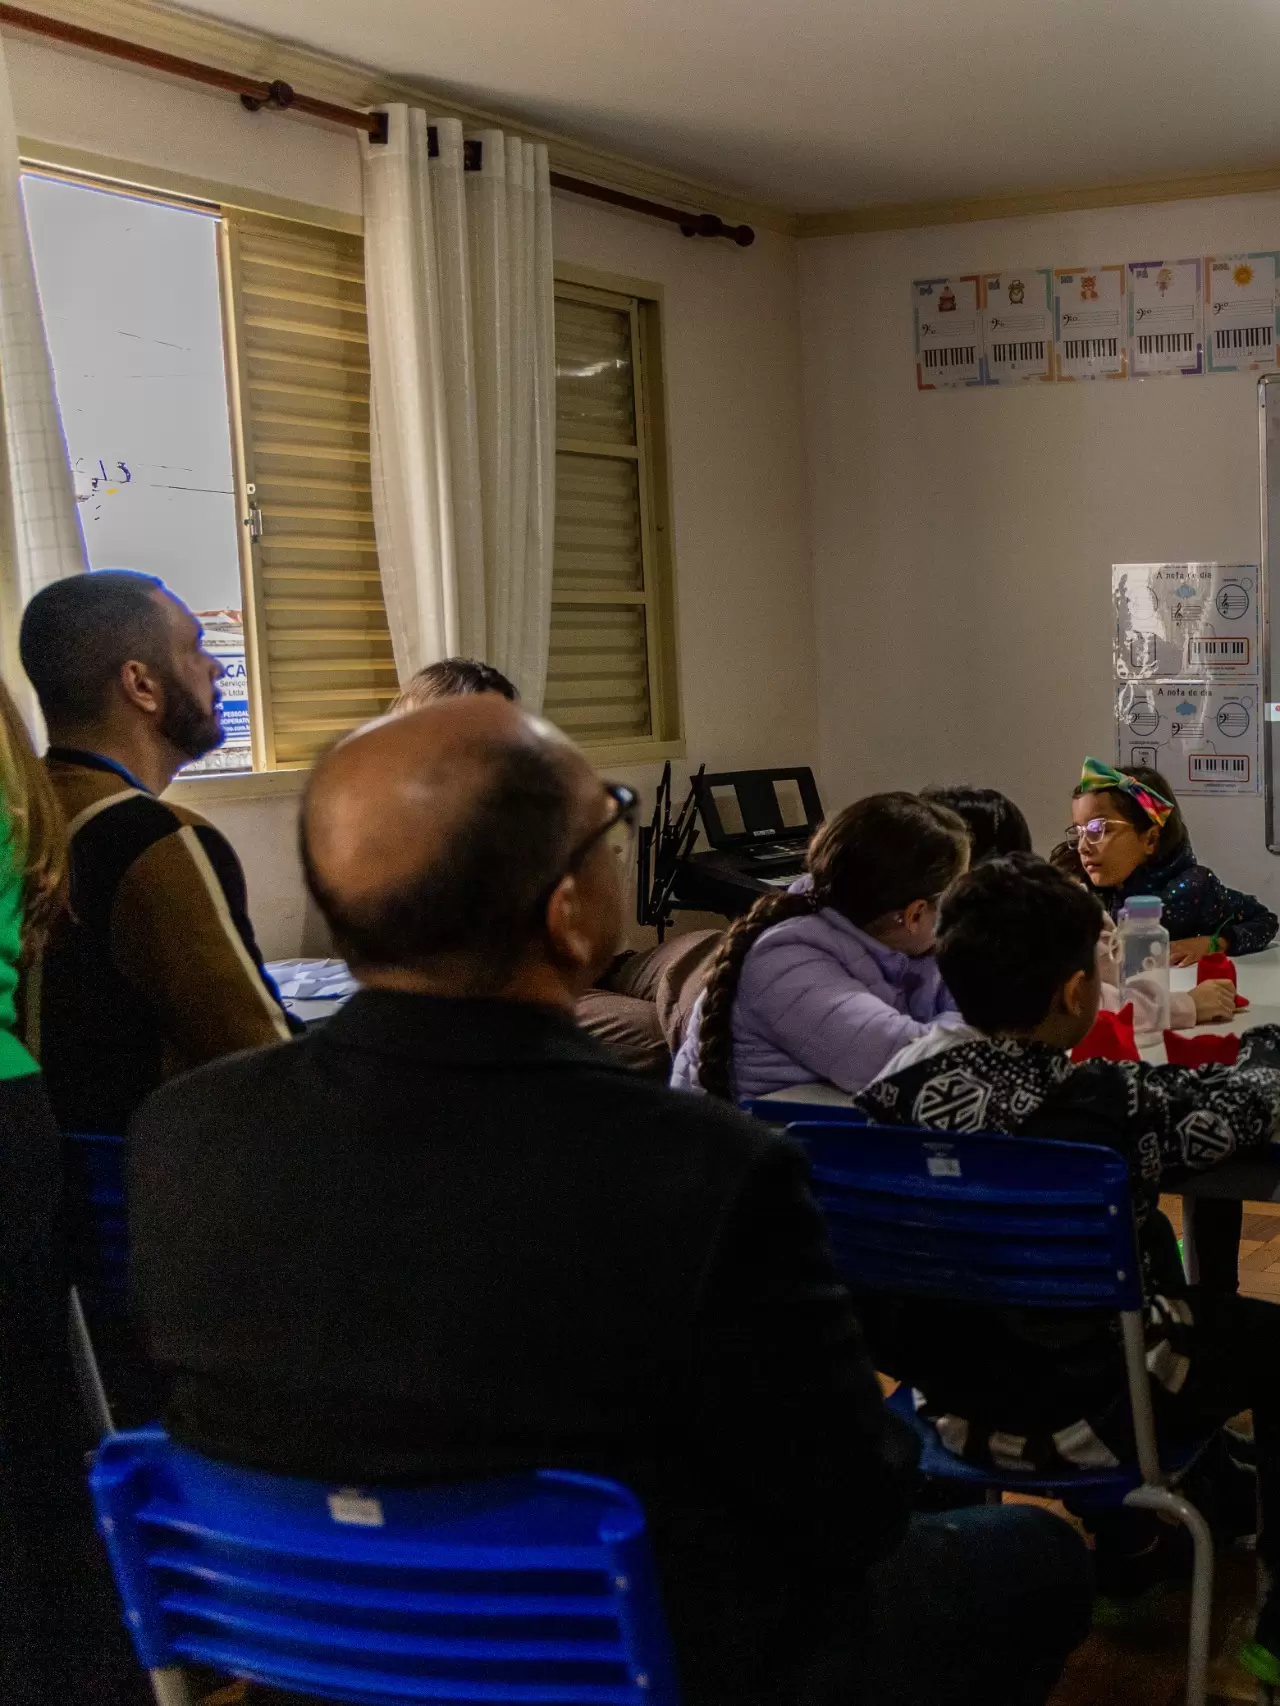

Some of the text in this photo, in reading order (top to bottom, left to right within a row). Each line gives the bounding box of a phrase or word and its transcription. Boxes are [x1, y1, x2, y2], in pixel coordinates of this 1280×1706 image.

[1156, 571, 1163, 579] A
[1199, 571, 1212, 579] dia
[225, 660, 247, 679] ÇÃ
[1157, 688, 1164, 696] A
[1167, 688, 1185, 696] nota
[1200, 688, 1212, 696] dia
